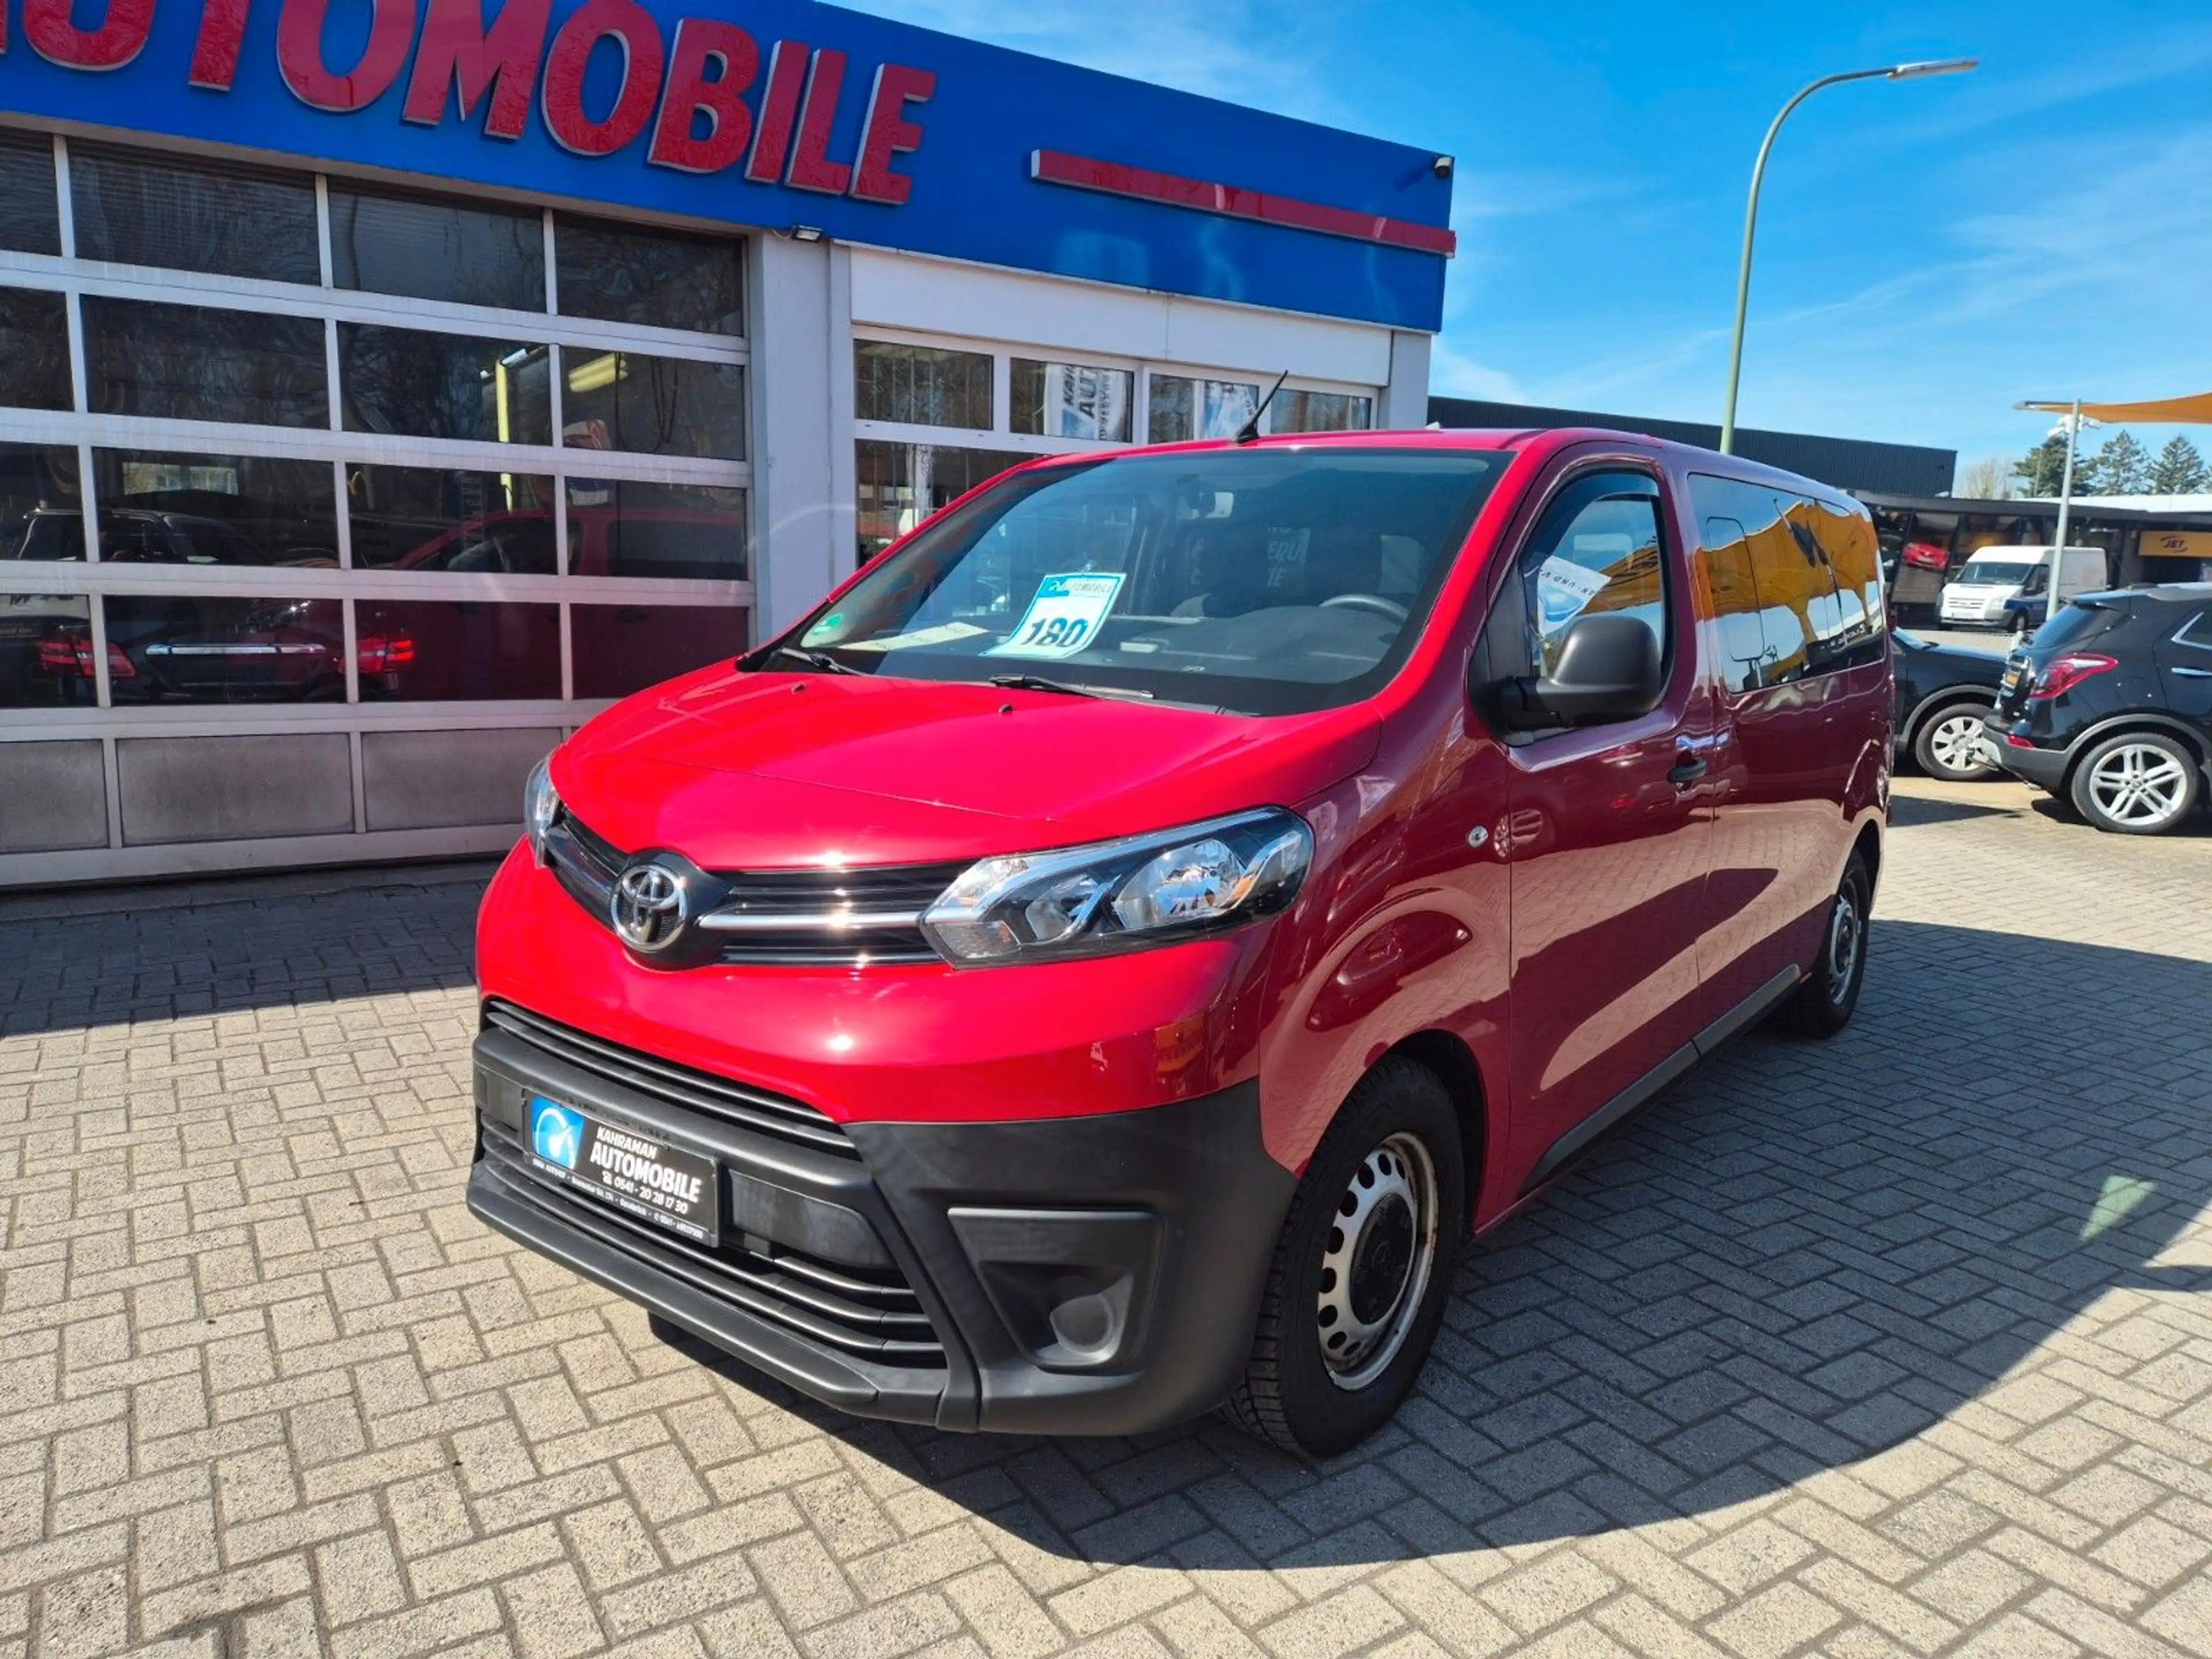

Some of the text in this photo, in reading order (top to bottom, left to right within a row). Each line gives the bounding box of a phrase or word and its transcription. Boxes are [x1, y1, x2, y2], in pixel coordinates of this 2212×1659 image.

[0, 0, 936, 204] OMOBILE
[2163, 540, 2186, 548] JET
[1020, 617, 1088, 647] 180
[596, 1126, 658, 1160] KAHRAMAN
[590, 1141, 702, 1203] AUTOMOBILE
